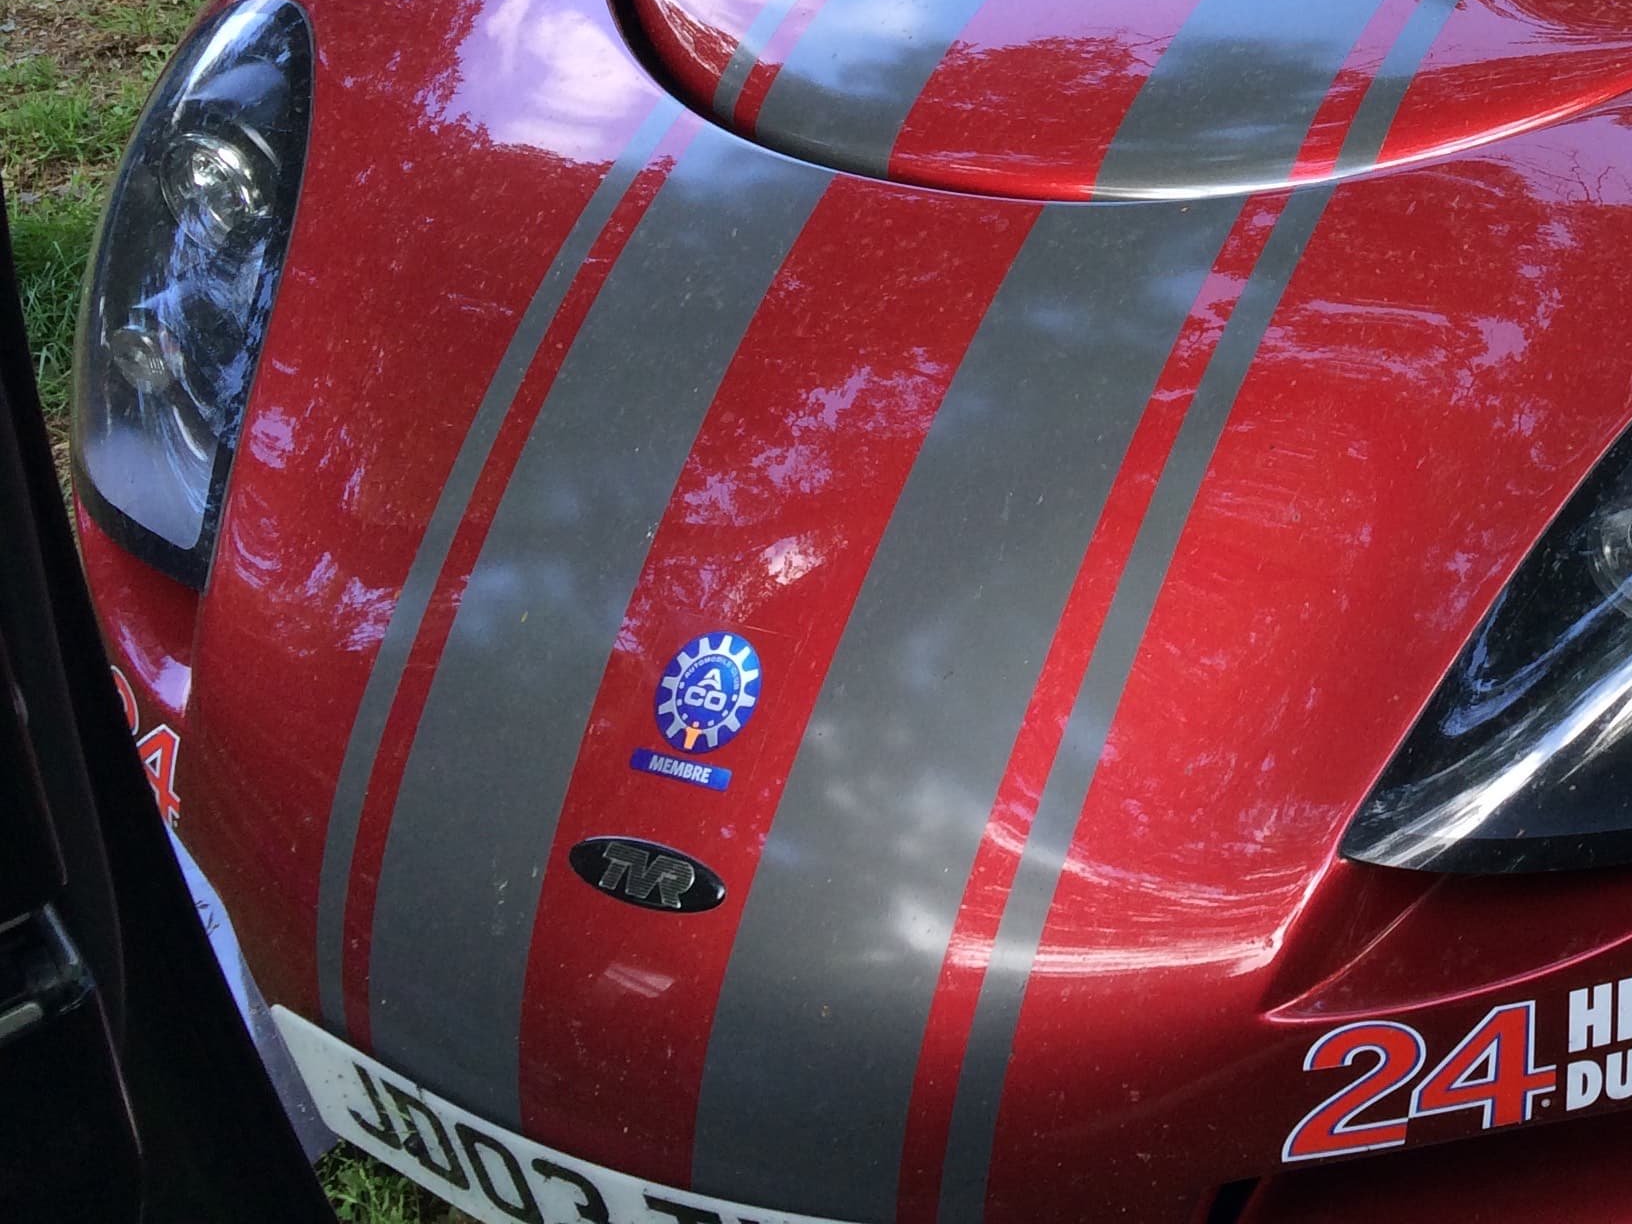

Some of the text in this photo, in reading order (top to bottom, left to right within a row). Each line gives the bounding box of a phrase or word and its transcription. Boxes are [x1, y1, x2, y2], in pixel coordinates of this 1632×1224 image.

[648, 753, 713, 785] MEMBRE
[598, 841, 696, 910] TVR
[1281, 999, 1557, 1164] 24
